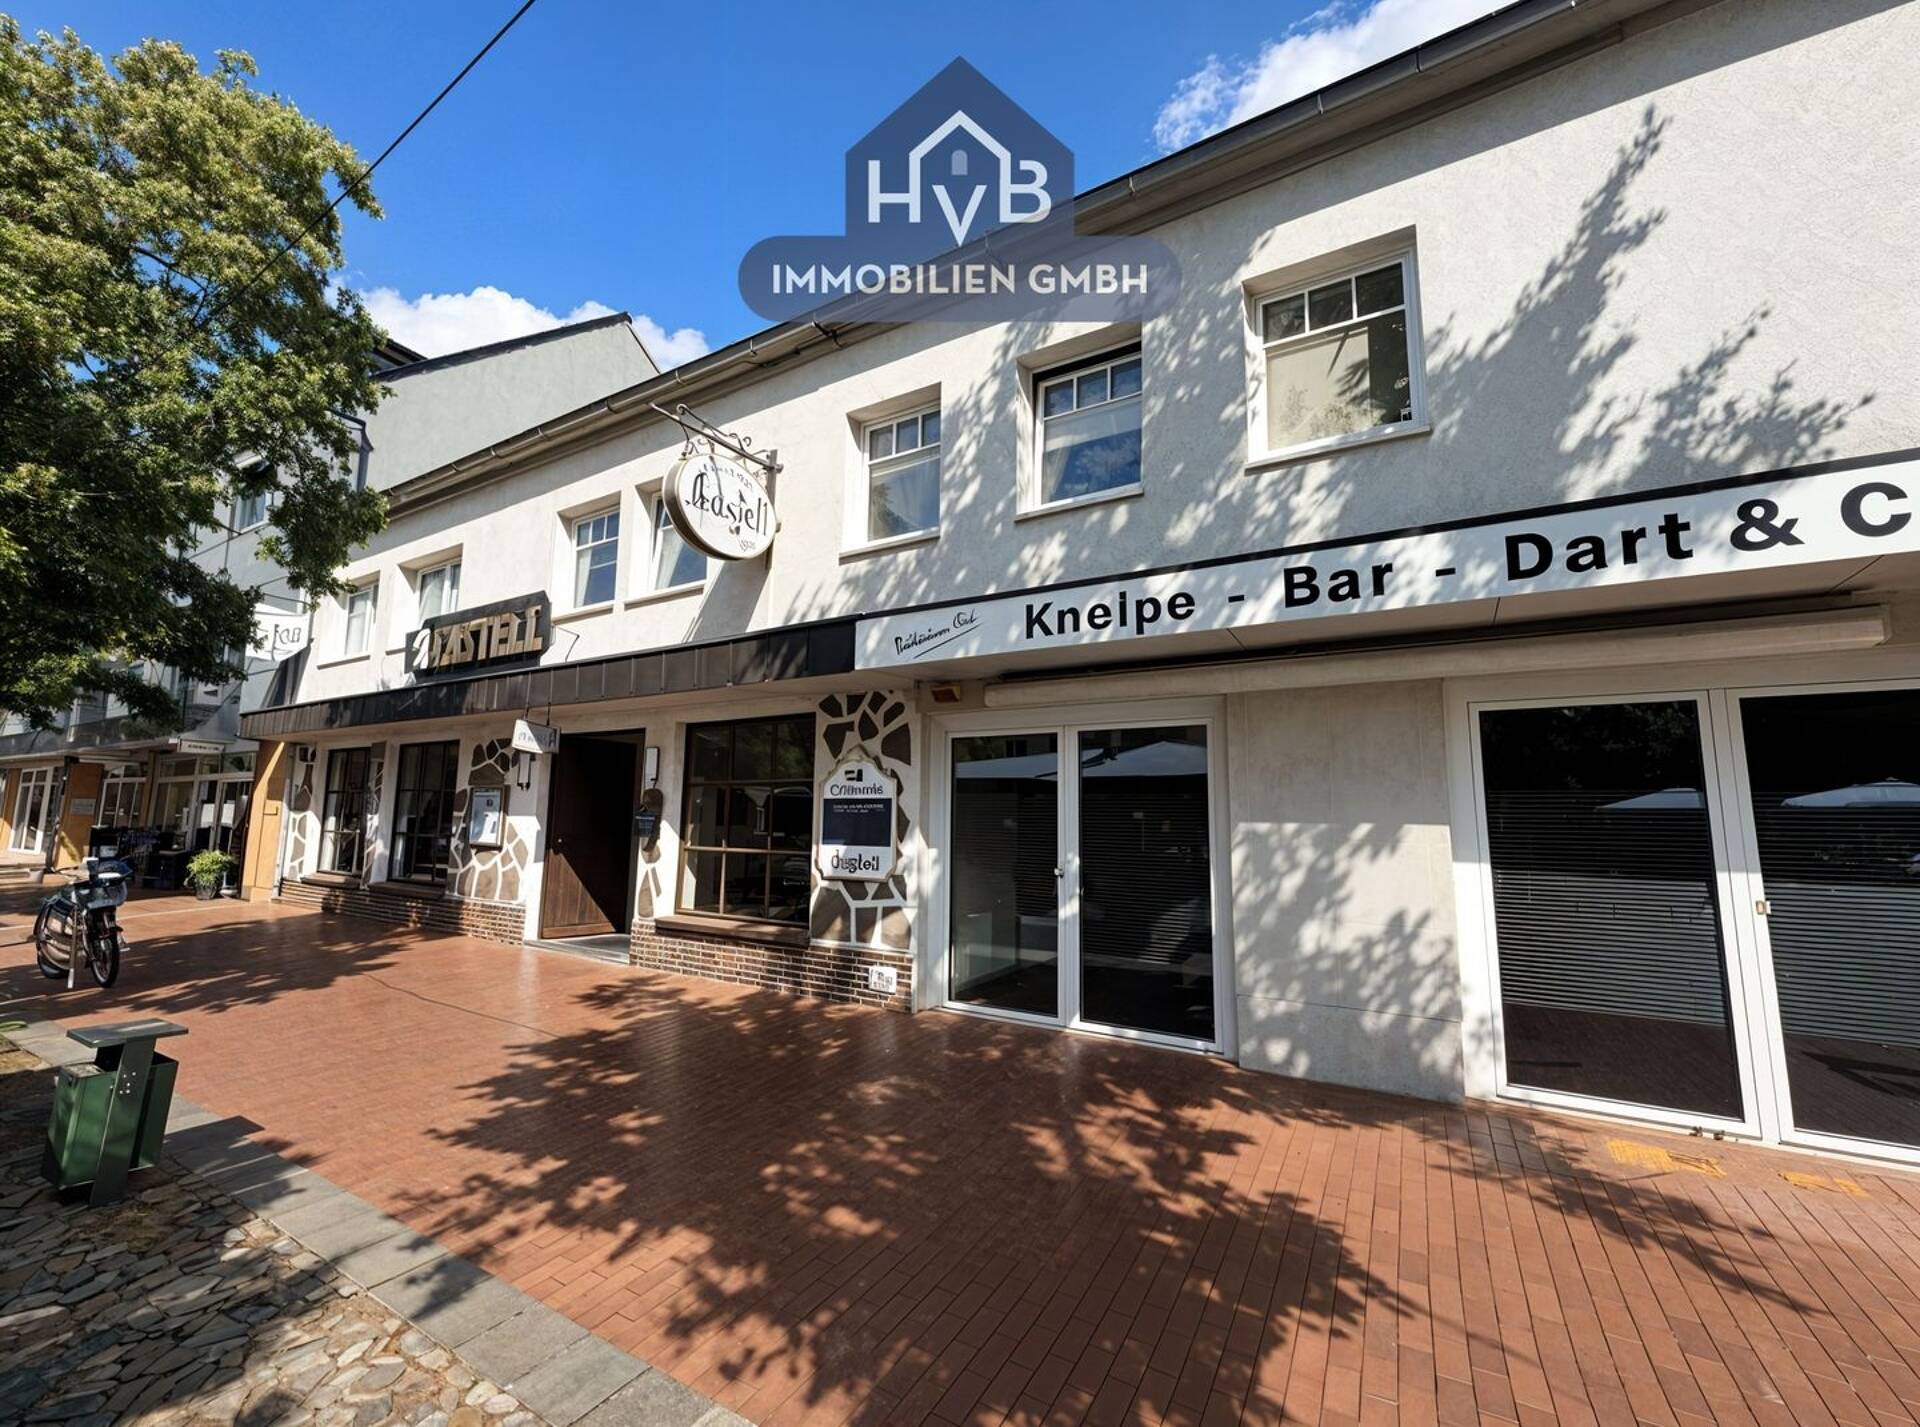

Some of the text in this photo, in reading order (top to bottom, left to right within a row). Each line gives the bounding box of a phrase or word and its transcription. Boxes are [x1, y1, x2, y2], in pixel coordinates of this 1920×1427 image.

[1024, 591, 1196, 640] Kneipe
[1283, 562, 1393, 608] Bar
[1505, 513, 1694, 581] Dart
[1730, 498, 1806, 552] &
